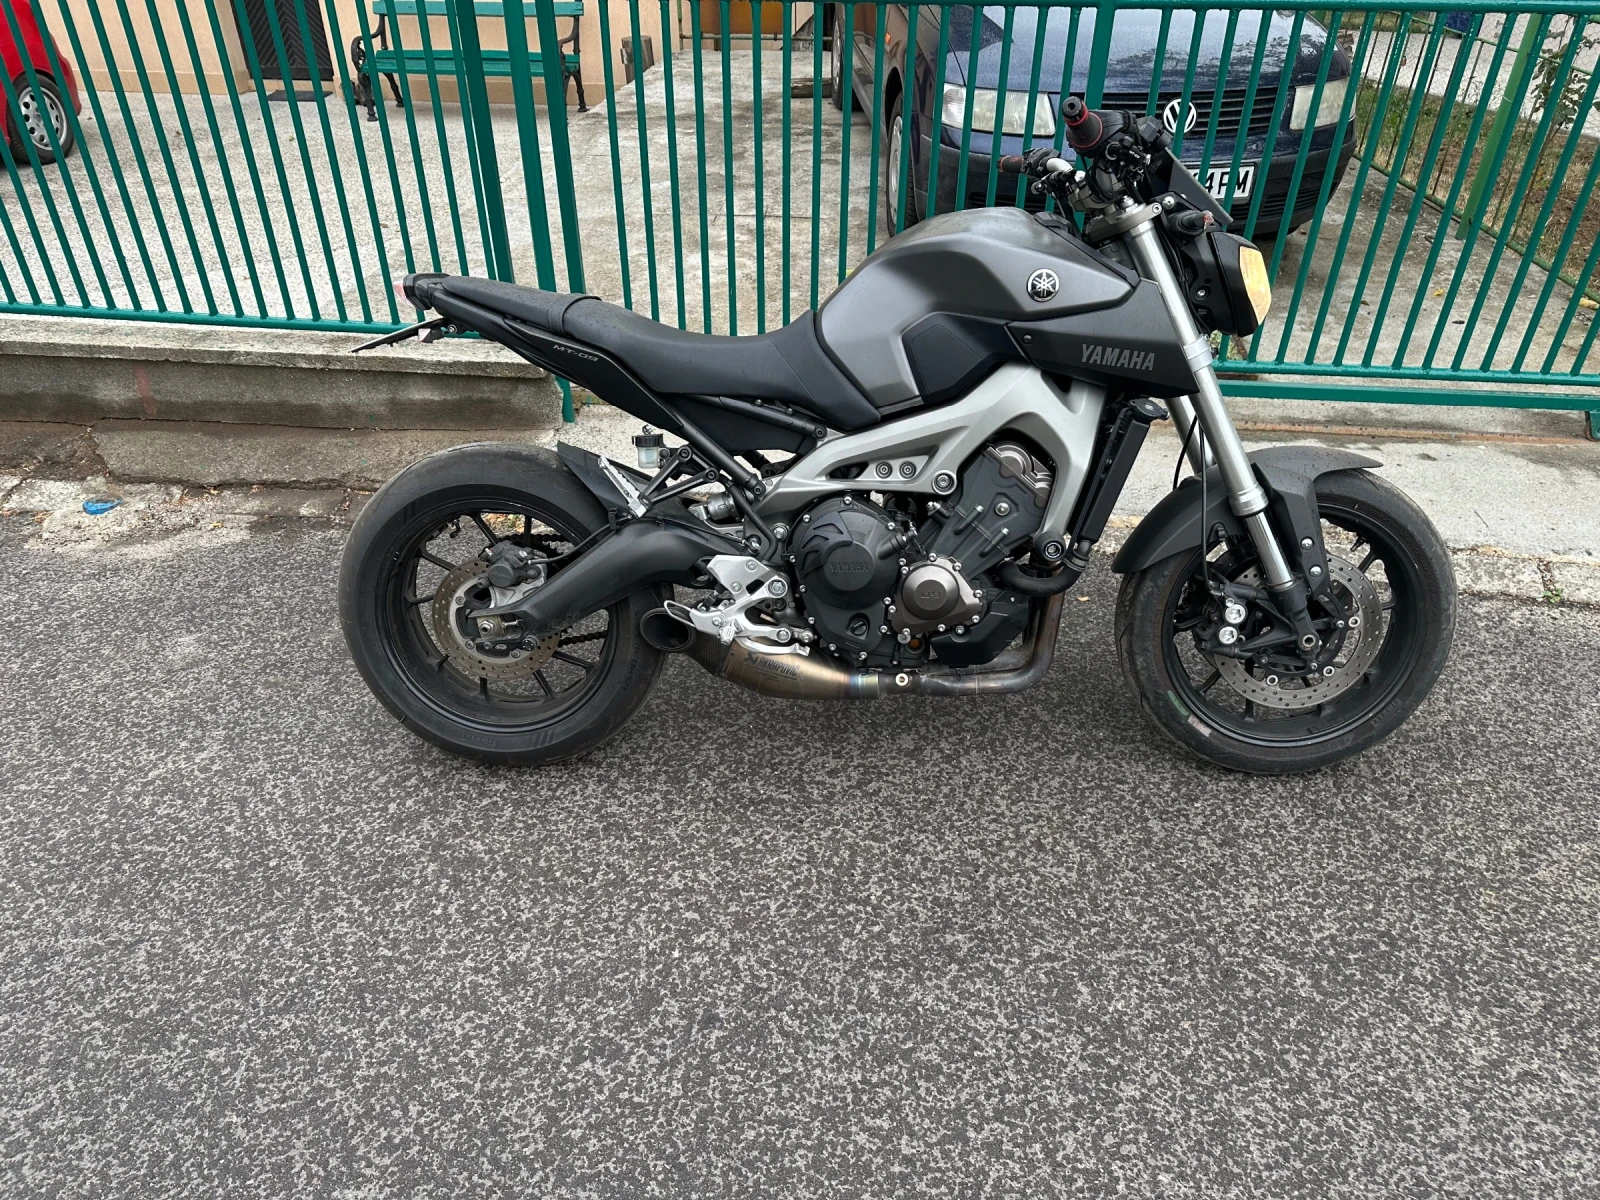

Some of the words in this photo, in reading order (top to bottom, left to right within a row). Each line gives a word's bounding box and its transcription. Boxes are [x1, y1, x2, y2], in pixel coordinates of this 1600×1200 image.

[553, 344, 599, 362] MT-09
[1081, 343, 1155, 371] YAMAHA
[829, 561, 869, 573] YAMAHA
